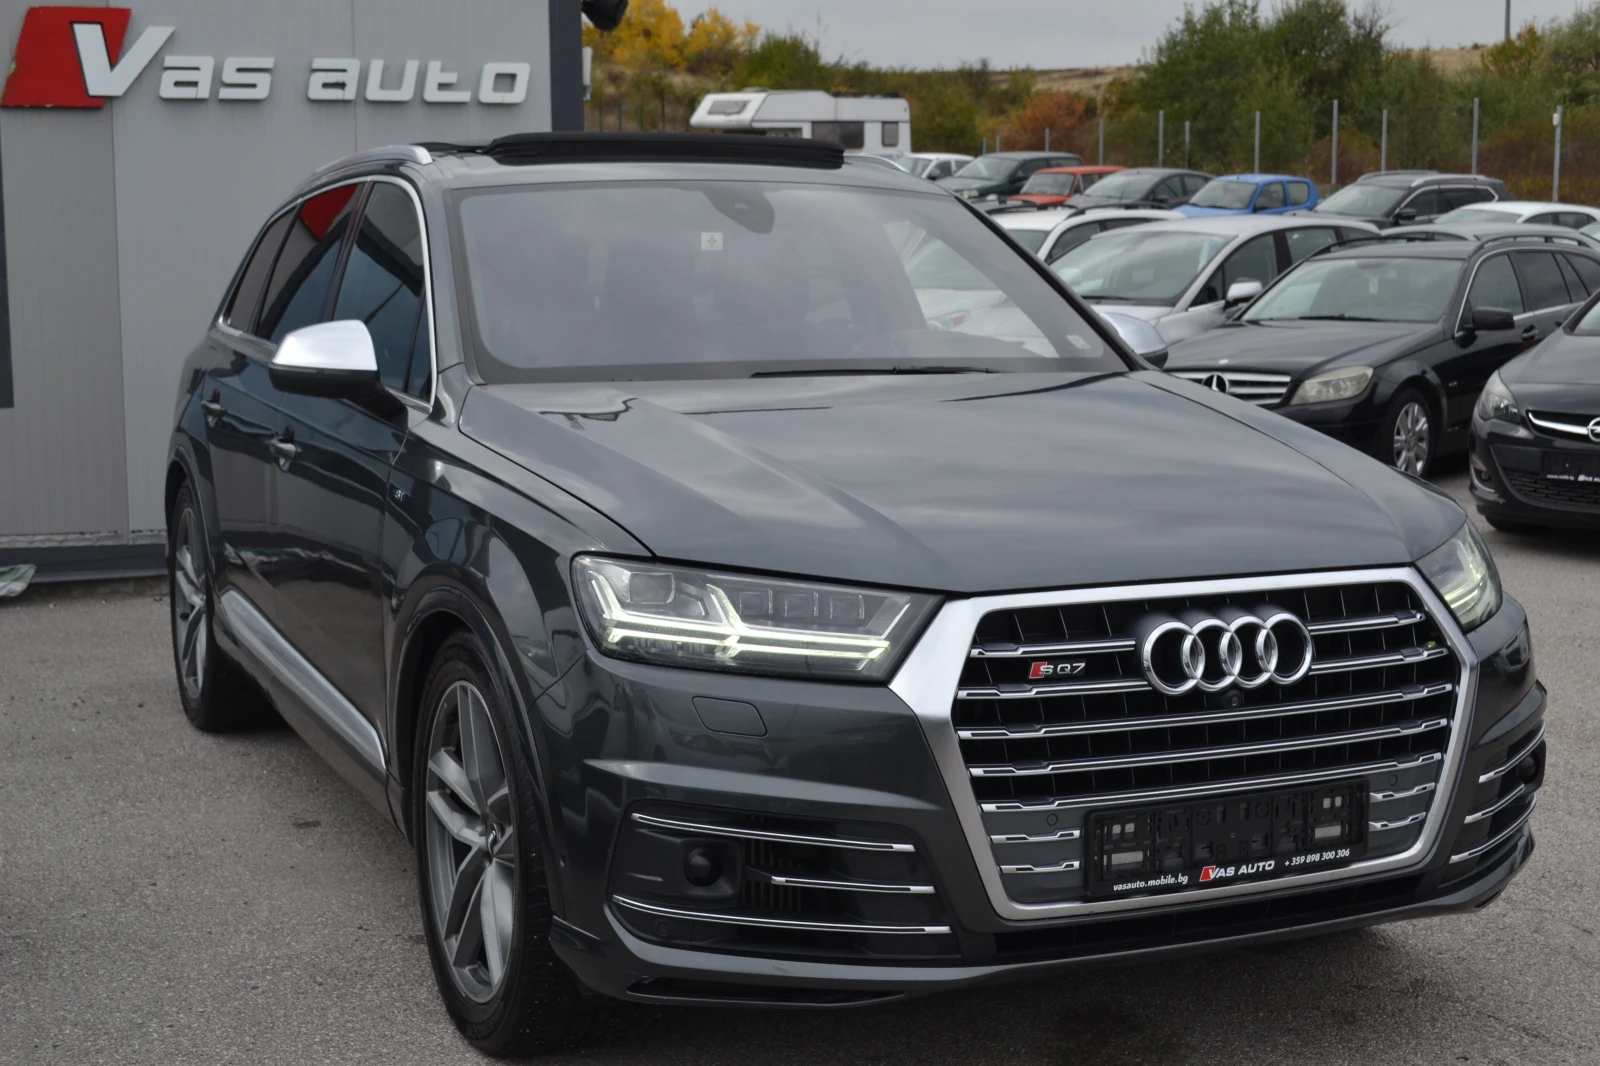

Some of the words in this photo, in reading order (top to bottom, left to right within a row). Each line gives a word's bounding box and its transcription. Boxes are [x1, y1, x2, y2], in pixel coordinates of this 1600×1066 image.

[70, 21, 274, 100] Vas
[307, 57, 531, 104] auto
[1290, 855, 1306, 866] 359
[1306, 853, 1321, 863] 898
[1321, 850, 1336, 861] 300
[1335, 848, 1350, 858] 306
[1208, 866, 1236, 880] VAS
[1237, 860, 1275, 875] AUTO
[1113, 872, 1189, 891] vasauto.mobile.bg
